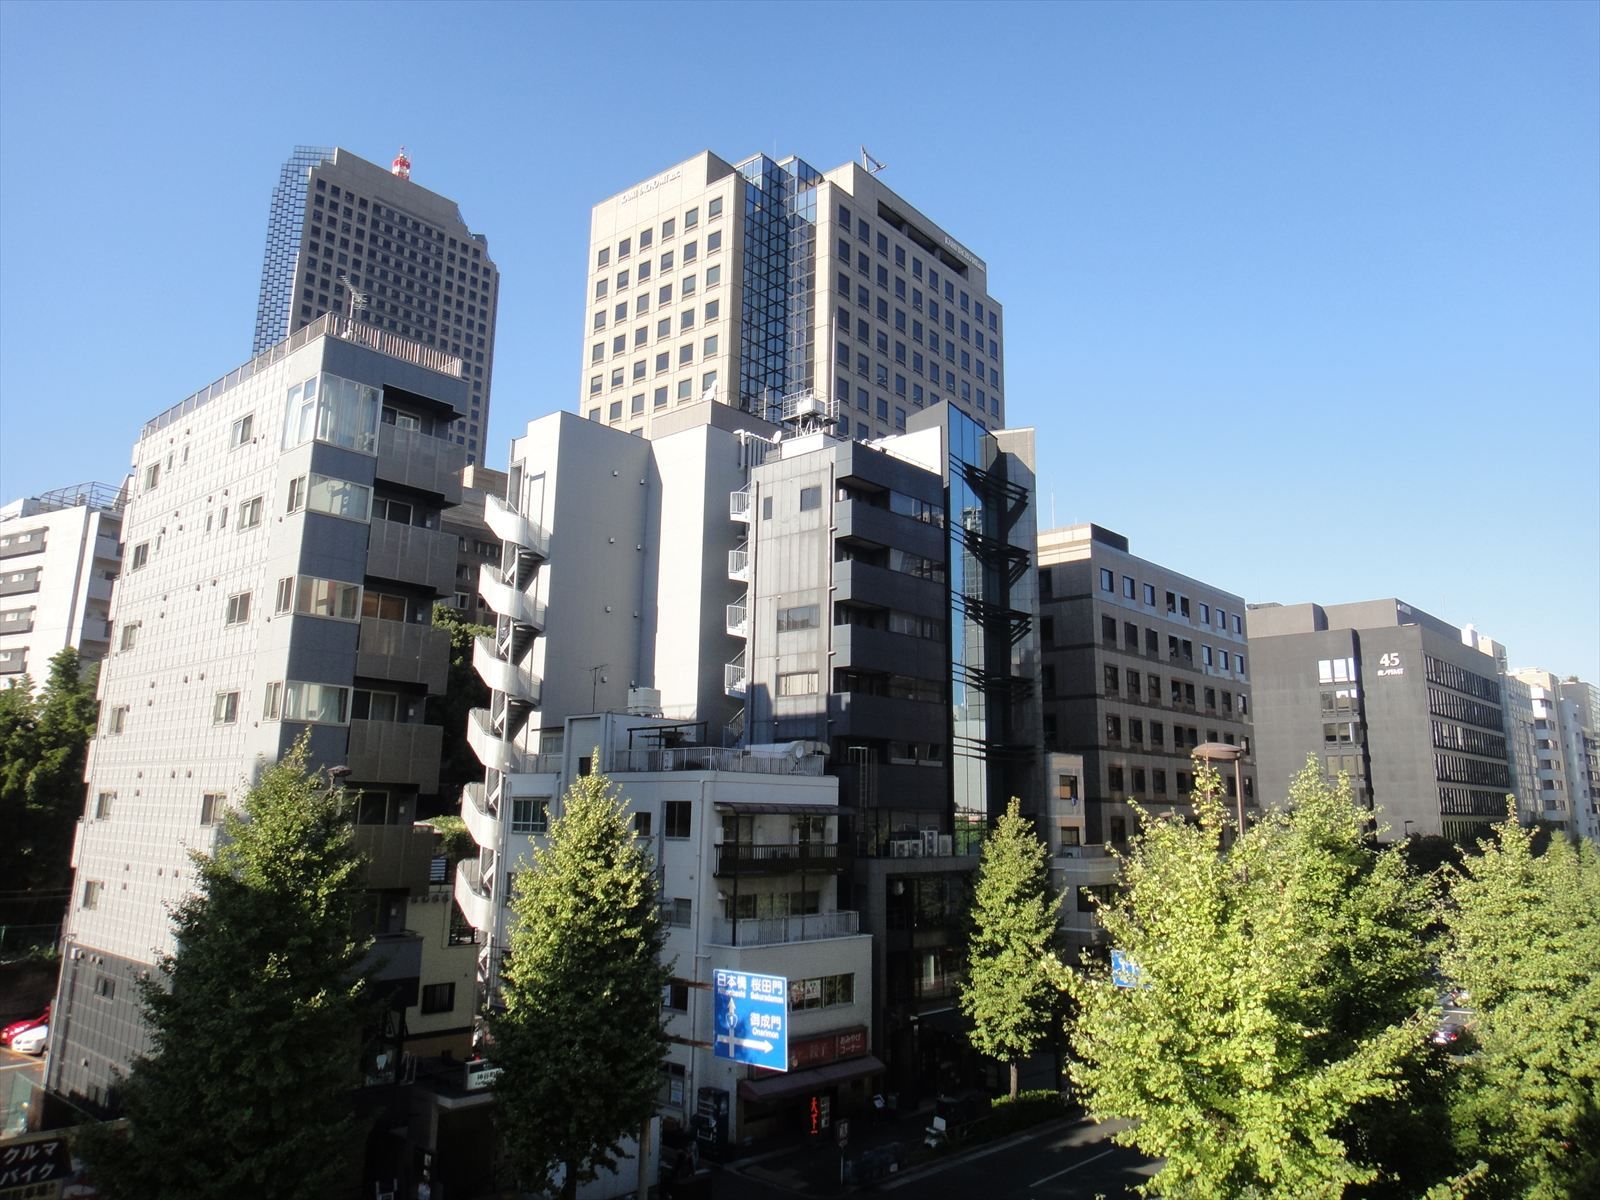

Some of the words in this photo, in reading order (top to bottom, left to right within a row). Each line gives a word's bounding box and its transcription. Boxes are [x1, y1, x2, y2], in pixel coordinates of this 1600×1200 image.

[1379, 652, 1400, 667] 45
[717, 973, 747, 990] 日本橋
[751, 977, 783, 995] 桜田門
[730, 1015, 734, 1025] 1
[750, 1012, 782, 1030] 御成門
[752, 1027, 779, 1039] Onarimon
[840, 1044, 862, 1055] コーナー
[3, 1142, 59, 1165] クルマ
[0, 1162, 56, 1185] バイク
